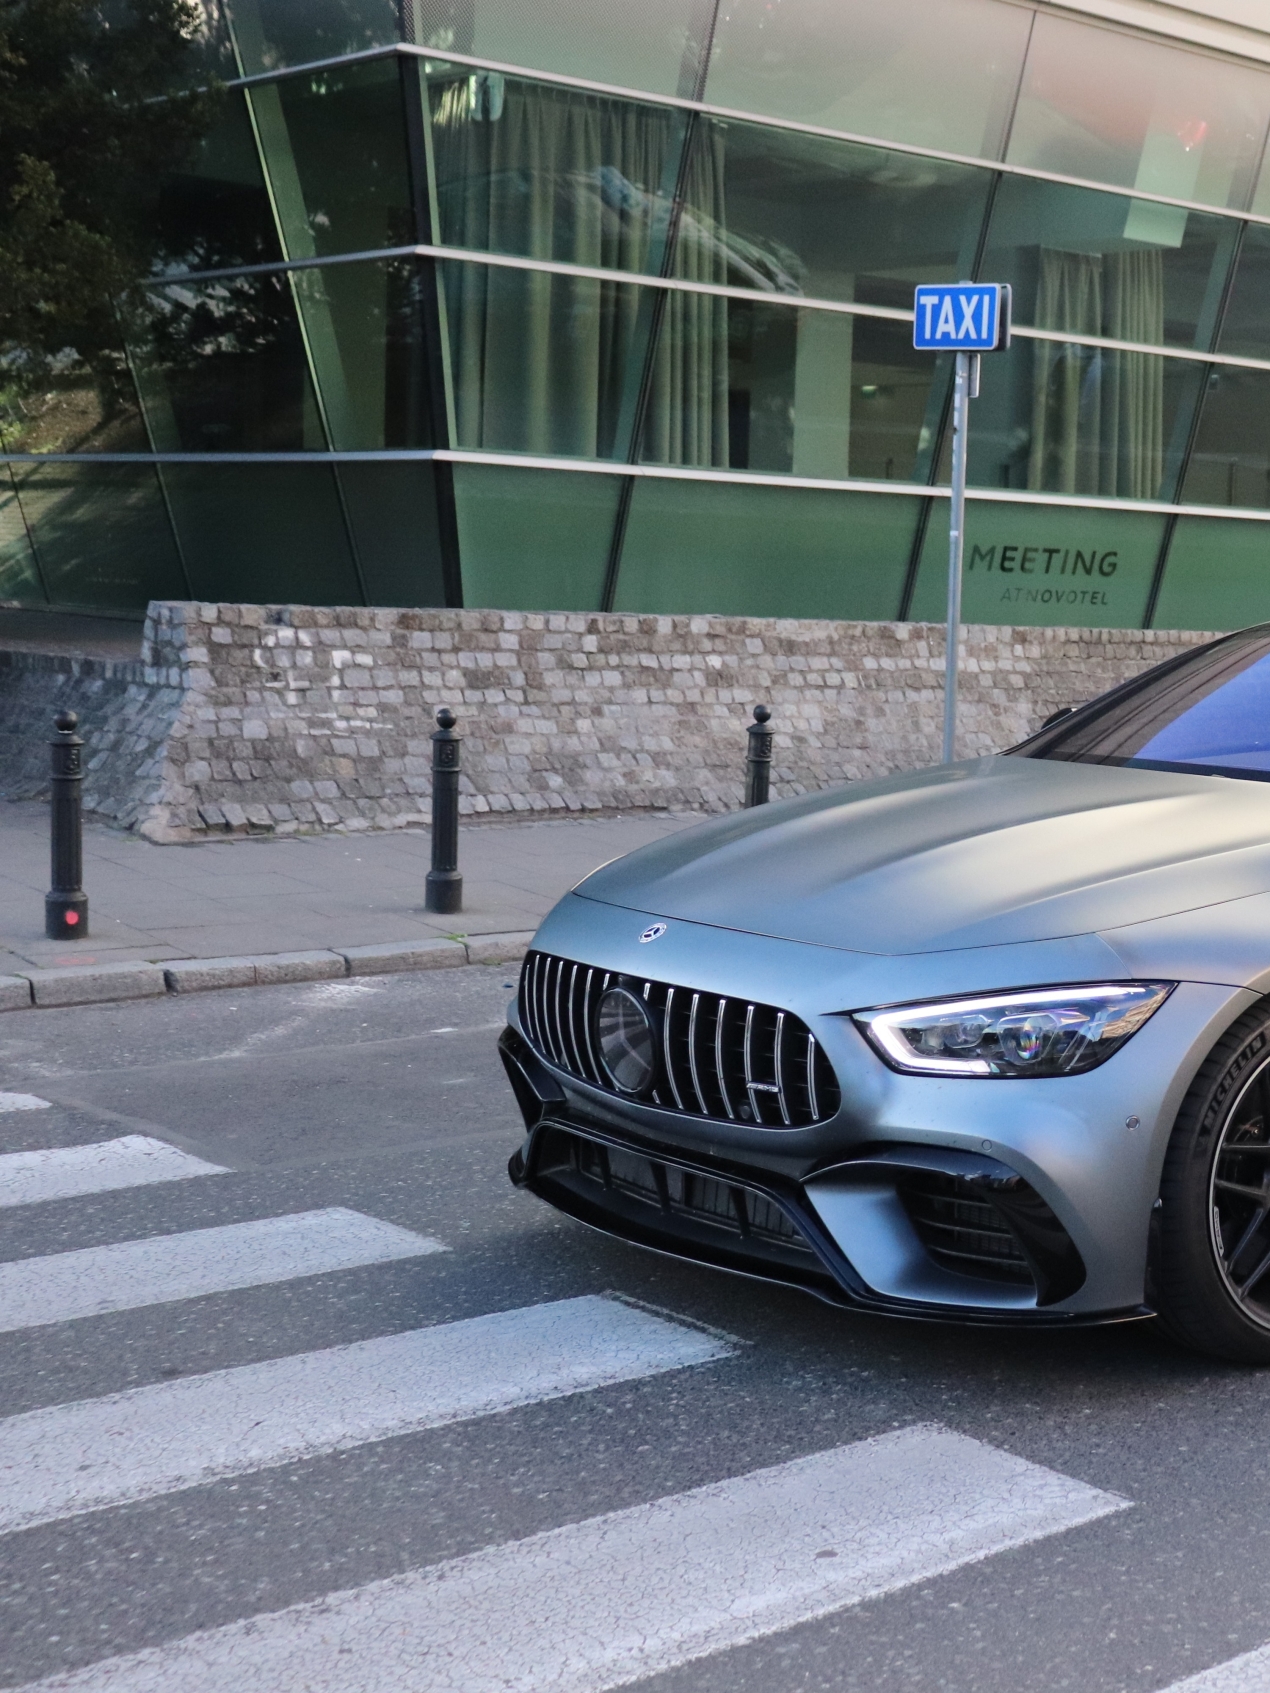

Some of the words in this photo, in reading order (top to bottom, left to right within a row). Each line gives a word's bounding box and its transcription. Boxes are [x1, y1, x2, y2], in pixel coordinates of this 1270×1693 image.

[920, 295, 989, 340] TAXI
[969, 544, 1118, 577] MEETING
[1026, 589, 1109, 605] NOVOTEL
[1203, 1034, 1265, 1131] MICHELIN
